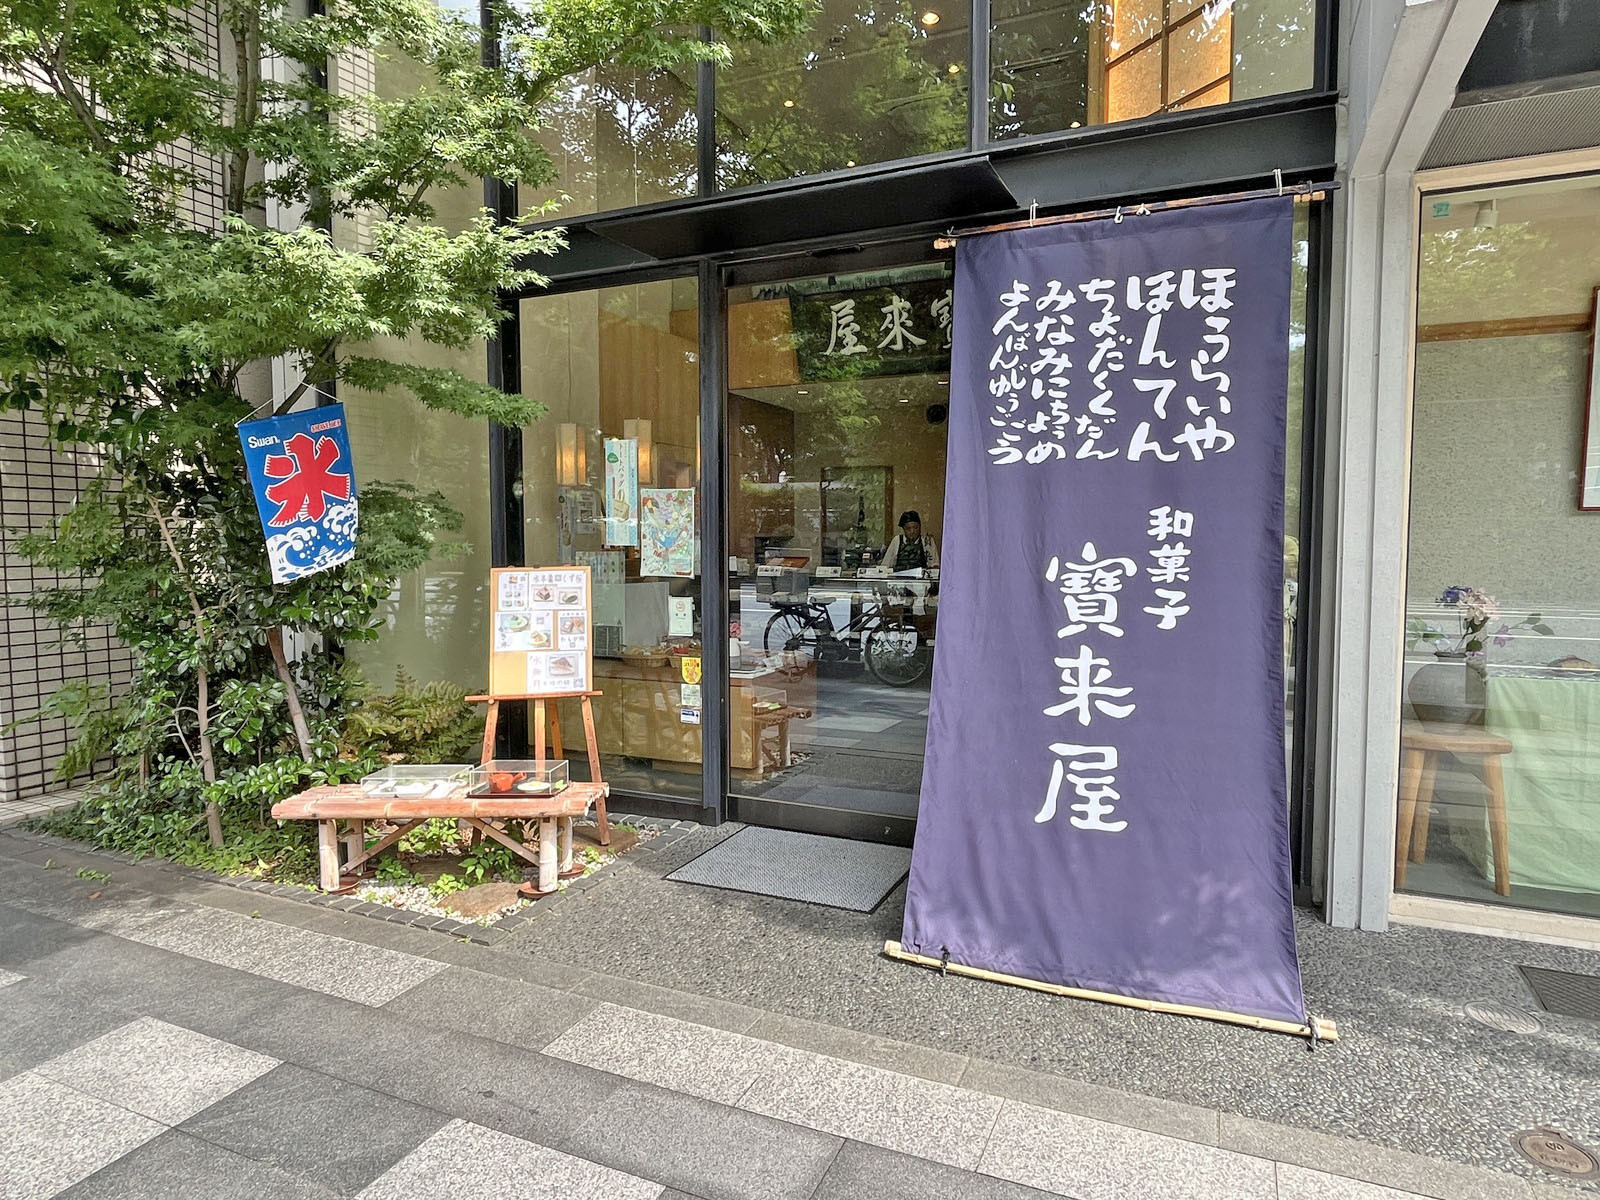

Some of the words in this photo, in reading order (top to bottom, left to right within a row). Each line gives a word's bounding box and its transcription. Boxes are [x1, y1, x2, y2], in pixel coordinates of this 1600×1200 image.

[1126, 271, 1180, 462] ほんてん
[1172, 268, 1237, 461] ほうらいや
[247, 435, 279, 449] Swan
[263, 432, 350, 528] 氷
[1143, 505, 1194, 630] 和菓子
